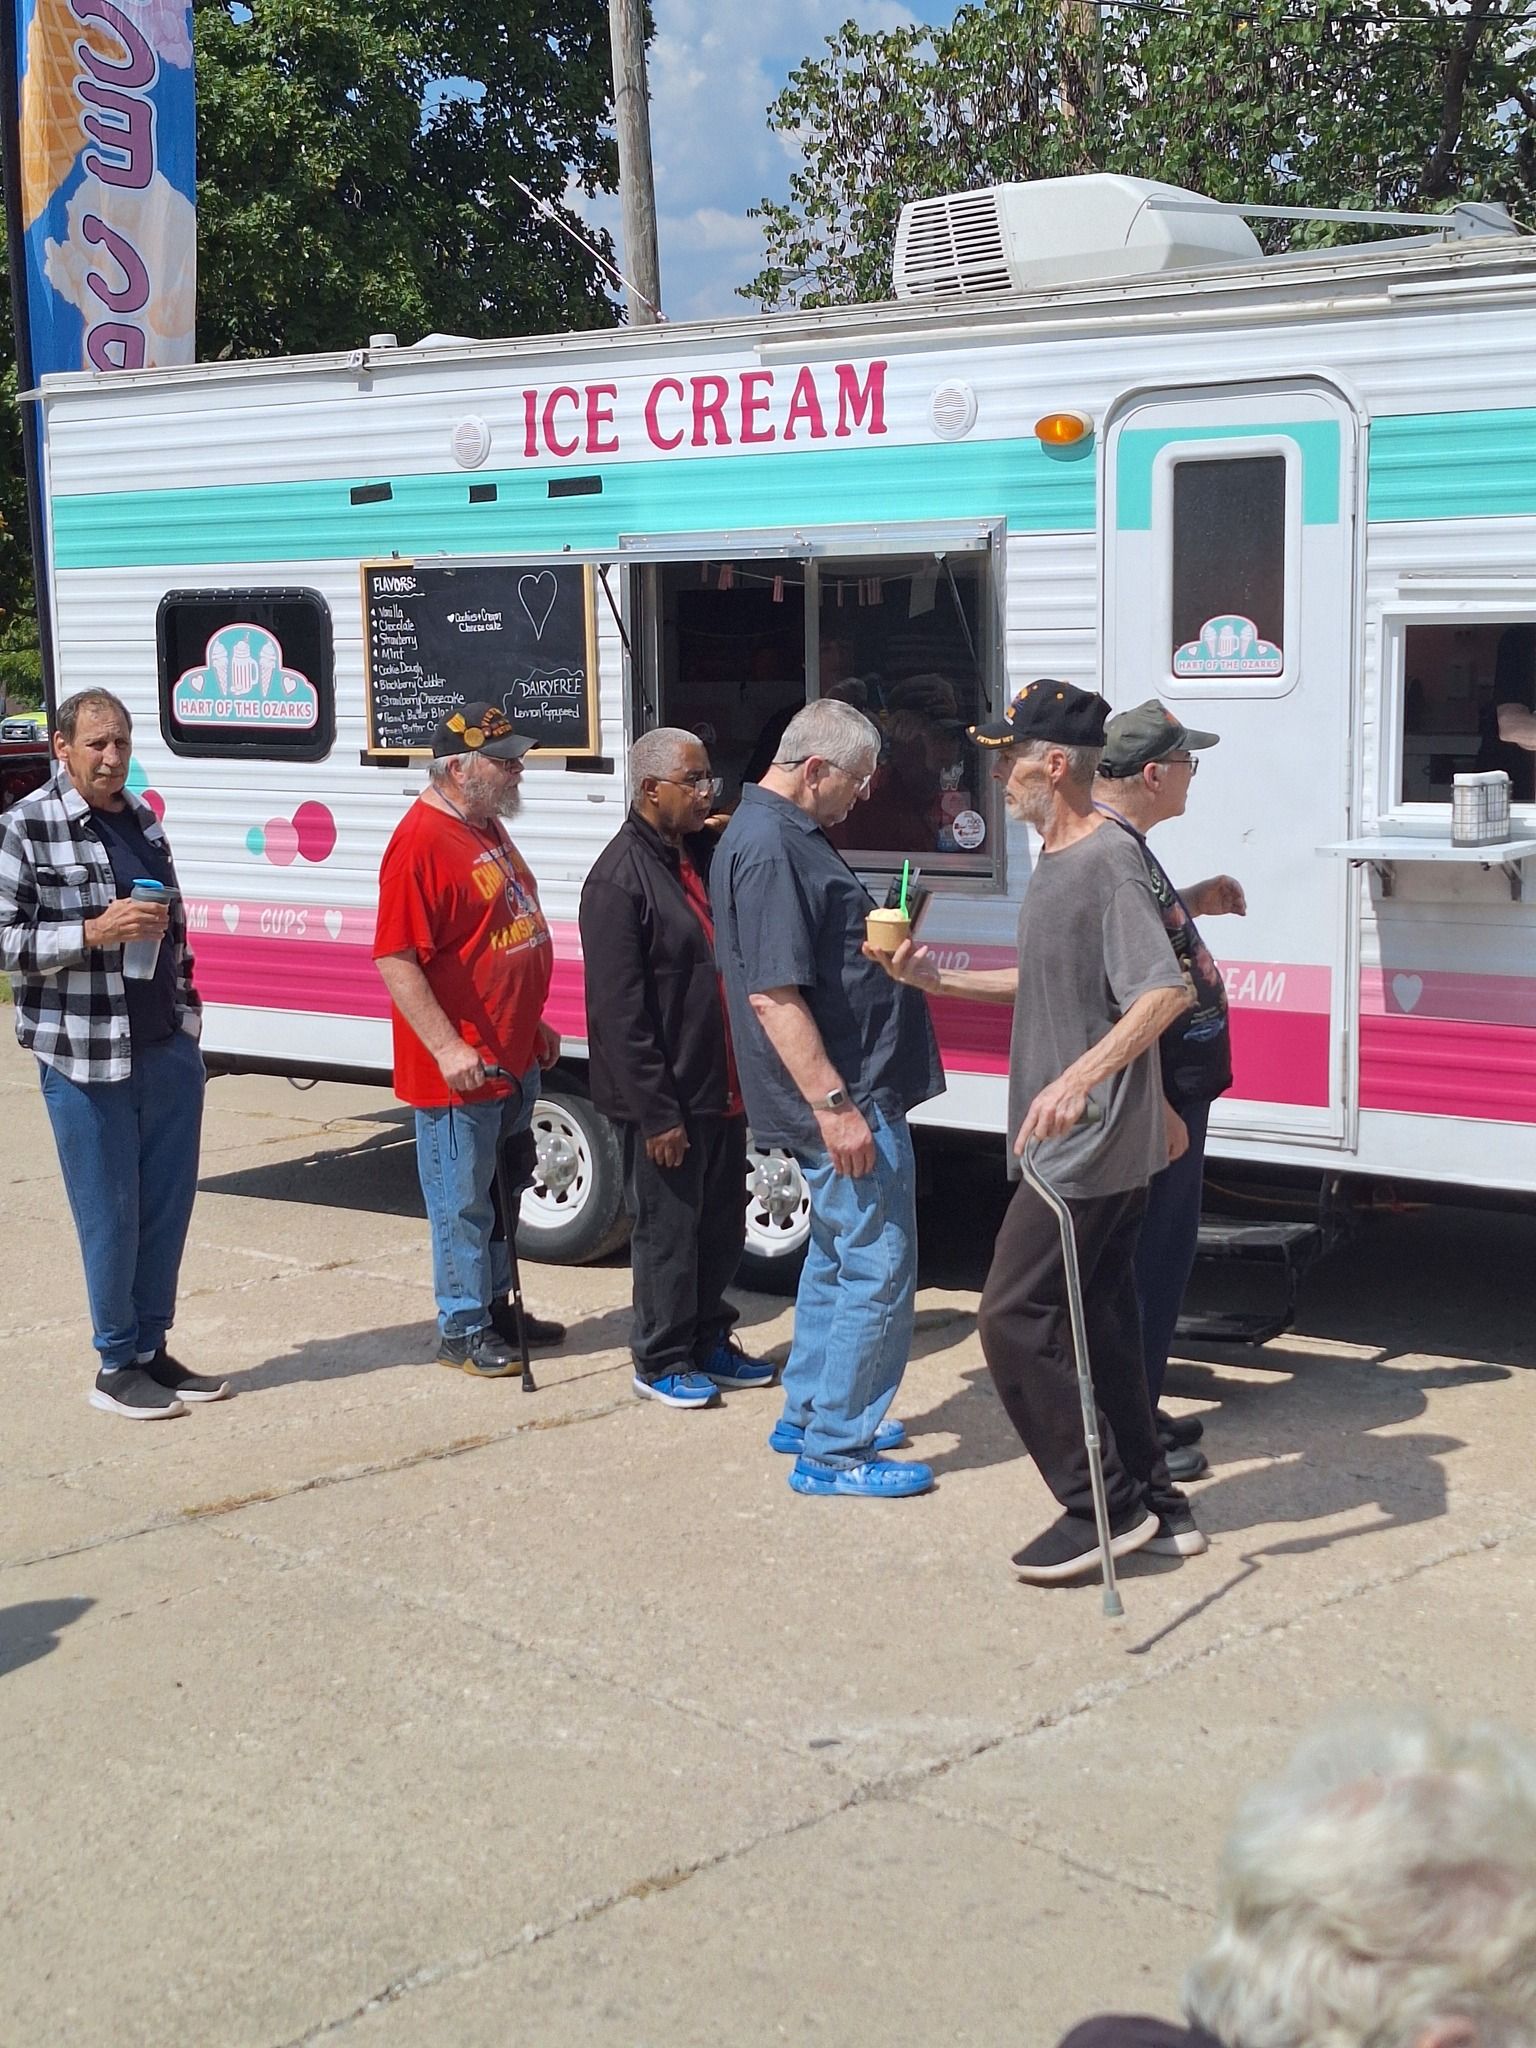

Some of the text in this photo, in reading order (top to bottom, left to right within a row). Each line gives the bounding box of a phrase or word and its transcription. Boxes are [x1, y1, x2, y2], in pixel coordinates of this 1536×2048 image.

[521, 360, 888, 458] ICE CREAM
[373, 576, 417, 593] FLAVORS:
[379, 618, 416, 632] Chocolate
[379, 631, 418, 651] Strawberry
[381, 647, 405, 660] Mint
[378, 661, 424, 679] Cookie Dough
[1179, 660, 1278, 670] HART OF THE OZARKS
[181, 701, 312, 717] HART OF THE OZARKS
[260, 908, 309, 935] CUPS
[1224, 967, 1286, 1003] EAM
